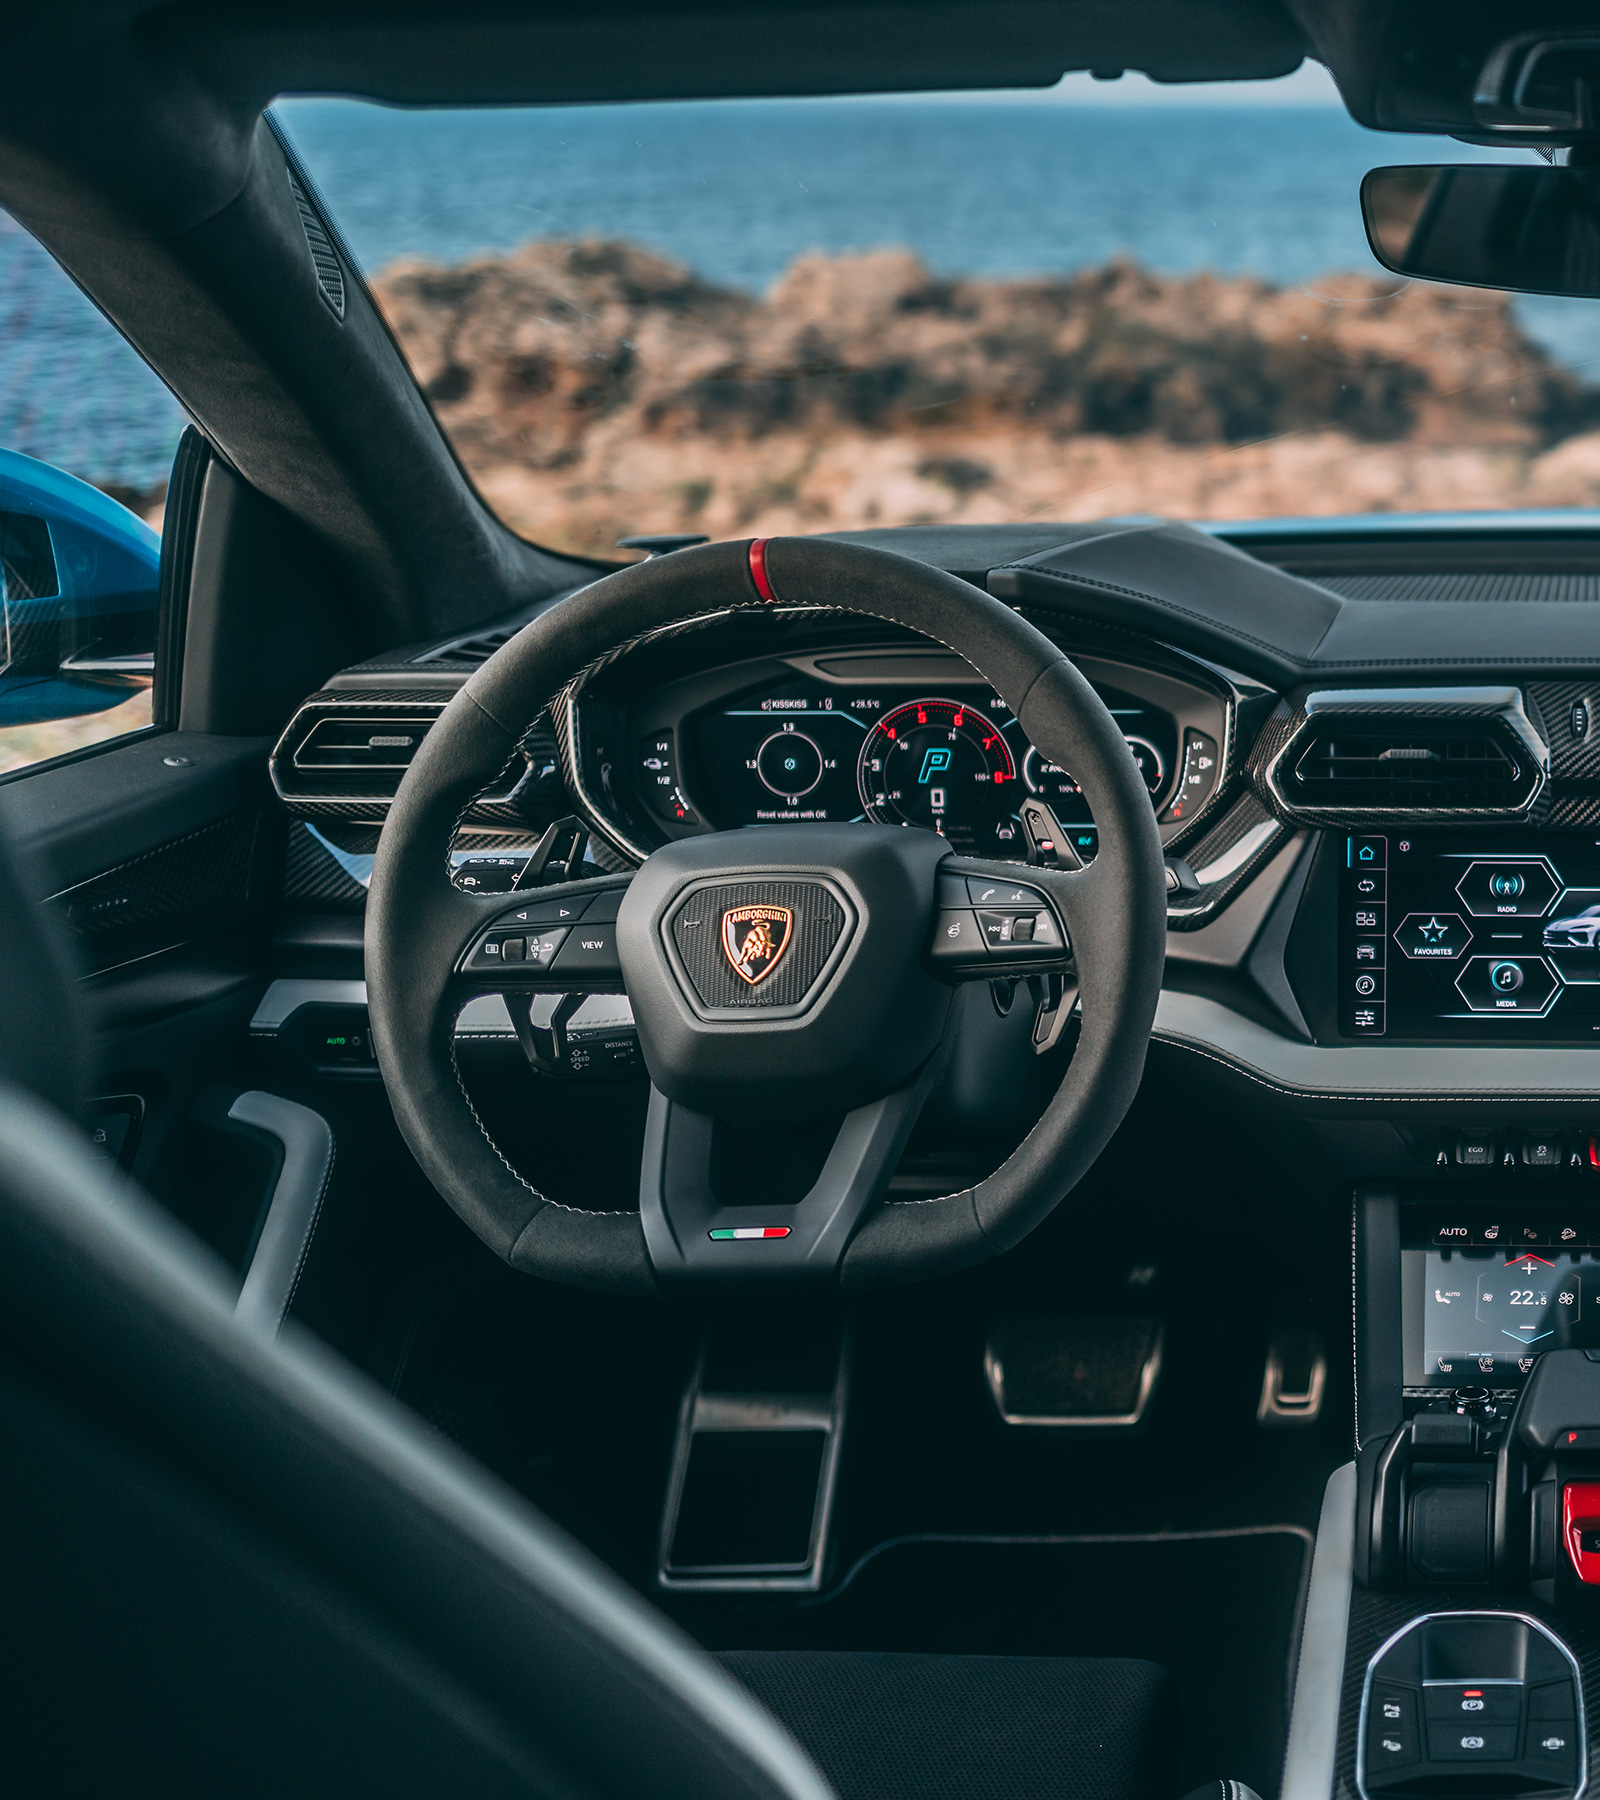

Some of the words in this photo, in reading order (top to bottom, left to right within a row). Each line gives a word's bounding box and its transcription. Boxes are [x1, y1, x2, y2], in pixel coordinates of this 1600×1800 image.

[772, 699, 807, 709] KISSKISS
[918, 712, 927, 724] 5
[953, 715, 963, 727] 6
[783, 723, 794, 732] 1.3
[887, 728, 897, 740] 4
[947, 732, 957, 741] 75
[656, 742, 668, 751] 1/1
[900, 742, 909, 751] 50
[982, 737, 991, 750] 7
[745, 759, 757, 769] 1.3
[824, 759, 836, 769] 1.4
[871, 759, 882, 772] 3
[918, 748, 952, 784] P
[657, 776, 671, 785] 1/2
[974, 773, 986, 781] 100
[994, 772, 1004, 784] 8
[876, 794, 886, 806] 2
[892, 791, 901, 799] 25
[930, 788, 946, 808] 0
[786, 797, 798, 806] 1.0
[757, 809, 776, 819] Reset
[777, 810, 802, 819] values
[803, 809, 814, 819] with
[815, 809, 827, 819] OK
[1497, 906, 1518, 914] RADIO
[727, 909, 787, 924] LAMBORGHINI
[530, 944, 541, 953] OK
[581, 940, 604, 950] VIEW
[1413, 947, 1453, 956] FAVOURITES
[1496, 1000, 1517, 1008] MEDIA
[326, 1037, 346, 1045] AUTO
[604, 1040, 634, 1049] DISTANCE
[570, 1055, 590, 1064] SPEED
[1467, 1146, 1484, 1154] EGO
[1439, 1227, 1468, 1237] AUTO
[1568, 1432, 1577, 1444] P
